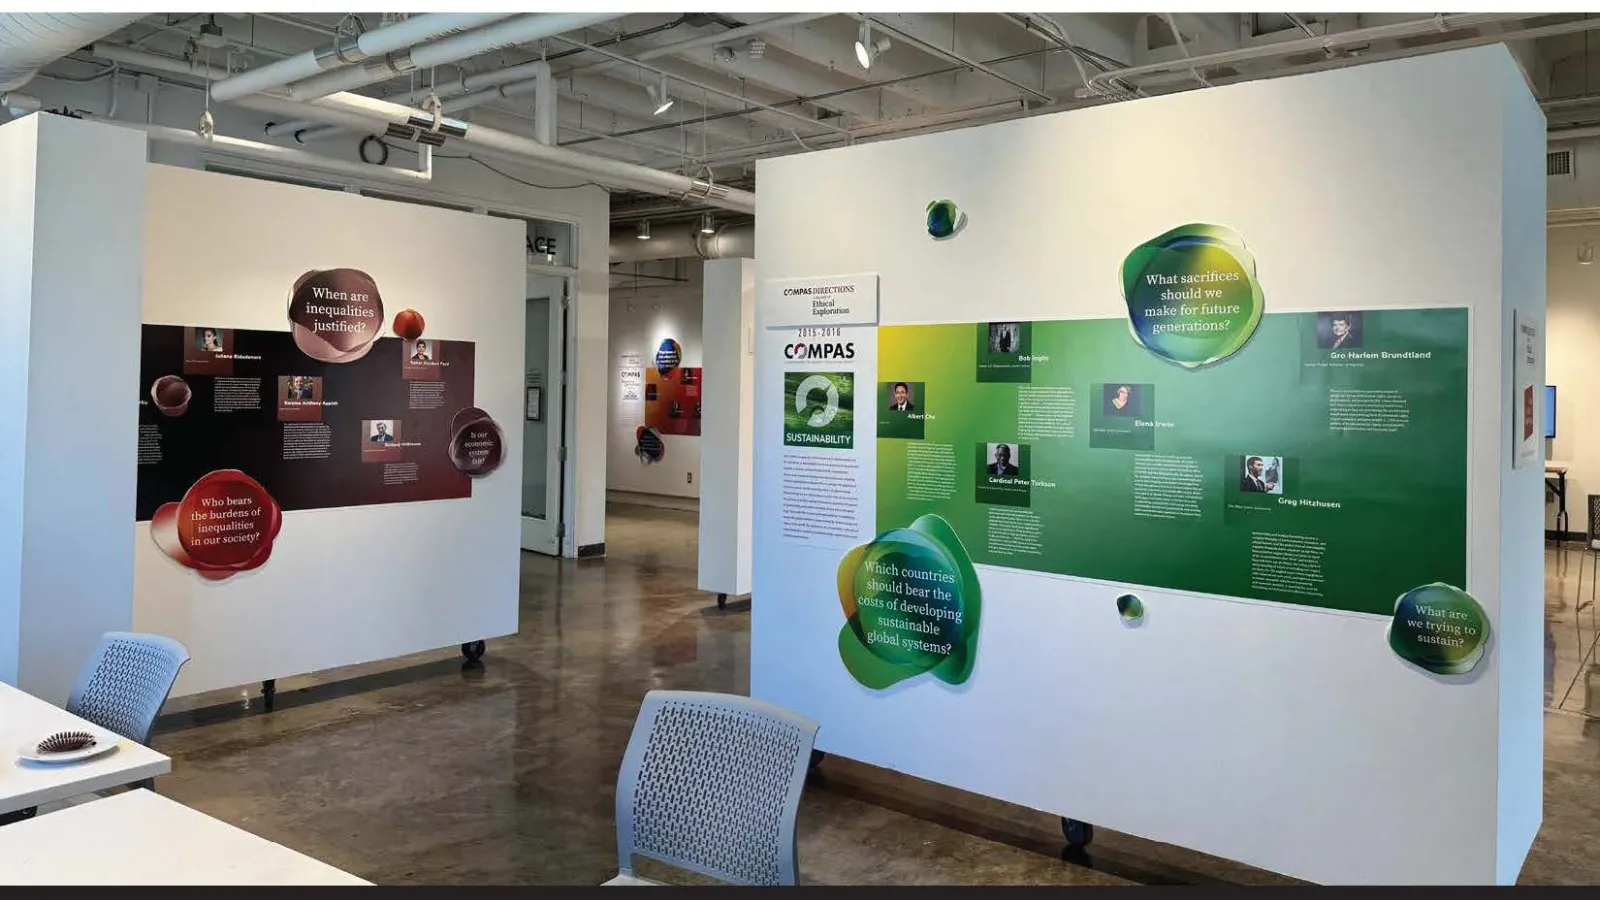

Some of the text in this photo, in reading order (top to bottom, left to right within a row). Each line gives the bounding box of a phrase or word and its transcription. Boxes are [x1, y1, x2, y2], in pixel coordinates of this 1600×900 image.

[1146, 270, 1239, 285] What sacrifices
[312, 287, 369, 302] When are
[784, 285, 854, 296] COMPAS DIRECTIONS
[1161, 288, 1223, 300] should we
[812, 299, 835, 307] Ethical
[1145, 303, 1240, 316] make for future
[306, 302, 374, 318] inequalities
[812, 307, 849, 317] Exploration
[312, 319, 367, 333] justified?
[798, 327, 841, 337] 2015-2016
[1152, 320, 1230, 335] generations?
[784, 342, 855, 359] COMPAS
[1330, 351, 1431, 359] Gro Harlem Brundtland
[464, 440, 494, 448] economic
[786, 432, 852, 444] SUSTAINABILITY
[469, 450, 489, 458] system
[988, 476, 1013, 484] Cardinal
[1013, 478, 1030, 486] Peter
[201, 496, 252, 507] Who bears
[1278, 497, 1341, 508] Greg Hitzhusen
[191, 507, 262, 521] the burdens of
[198, 521, 254, 533] inequalities
[191, 531, 260, 546] in our society?
[865, 561, 955, 584] Which countries
[867, 578, 952, 601] should bear the
[858, 596, 963, 624] costs of developing
[1415, 604, 1468, 620] What are
[878, 616, 940, 635] sustainable
[1407, 620, 1476, 635] we trying to
[867, 630, 952, 655] global systems?
[1417, 634, 1464, 647] sustain?
